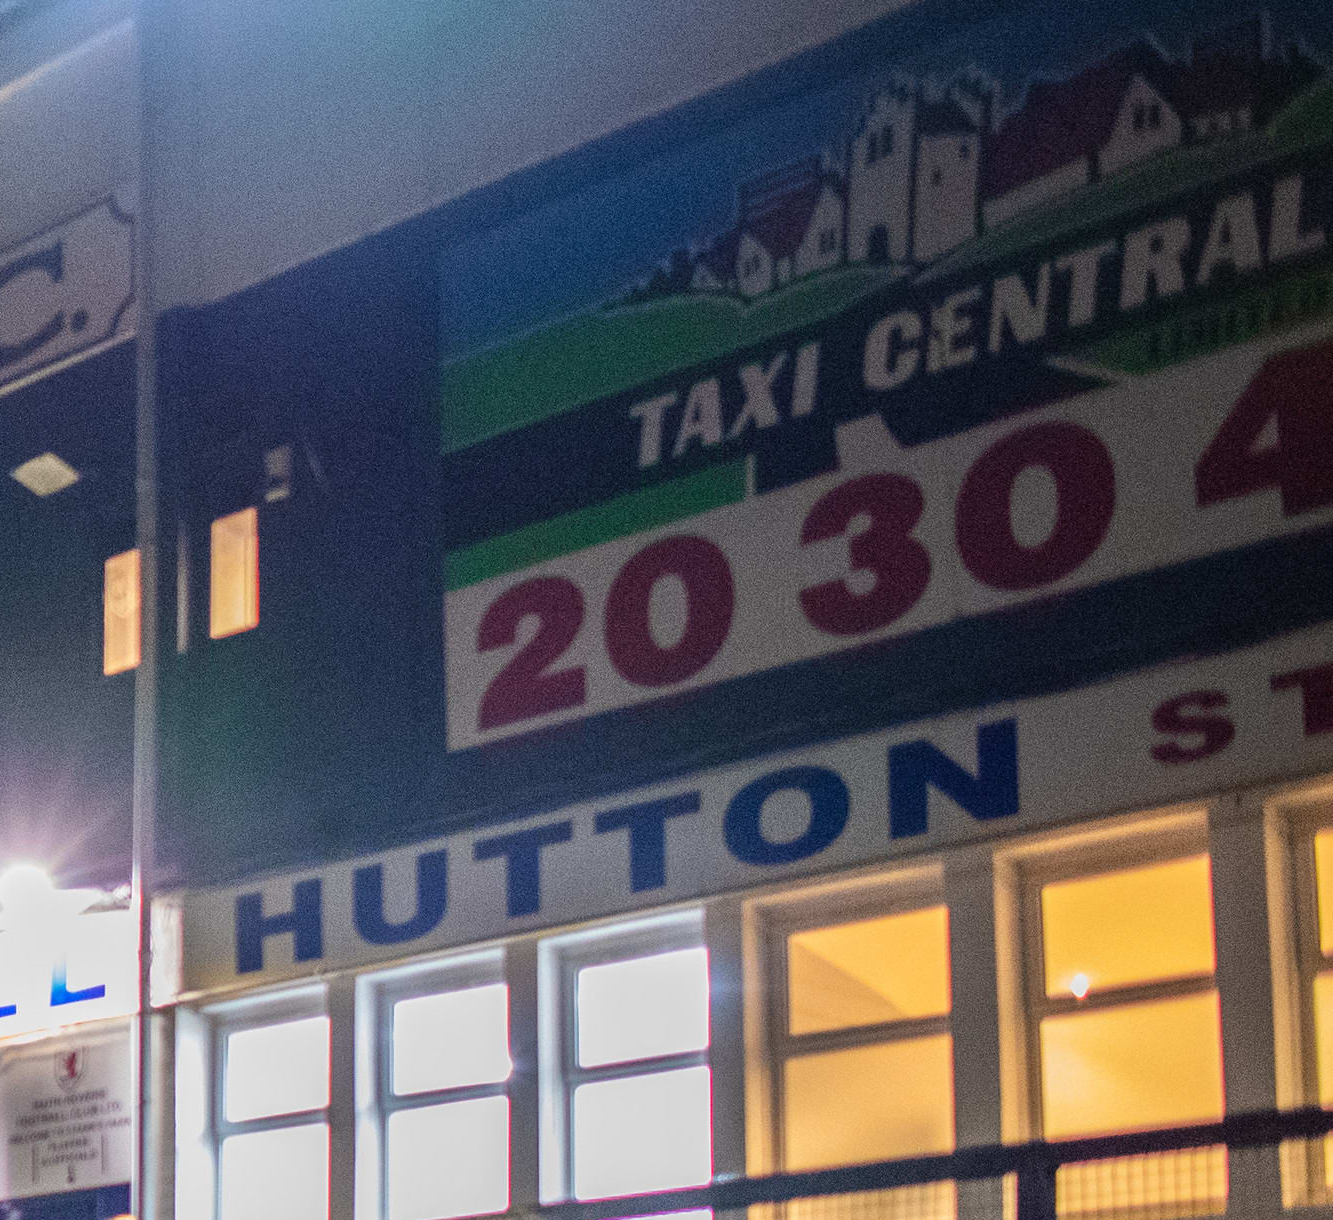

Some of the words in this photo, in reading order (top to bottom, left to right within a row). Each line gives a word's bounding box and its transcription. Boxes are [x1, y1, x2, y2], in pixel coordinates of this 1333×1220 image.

[629, 342, 820, 469] TAXI
[863, 173, 1326, 391] CENTRAL
[235, 716, 1021, 974] HUTTON
